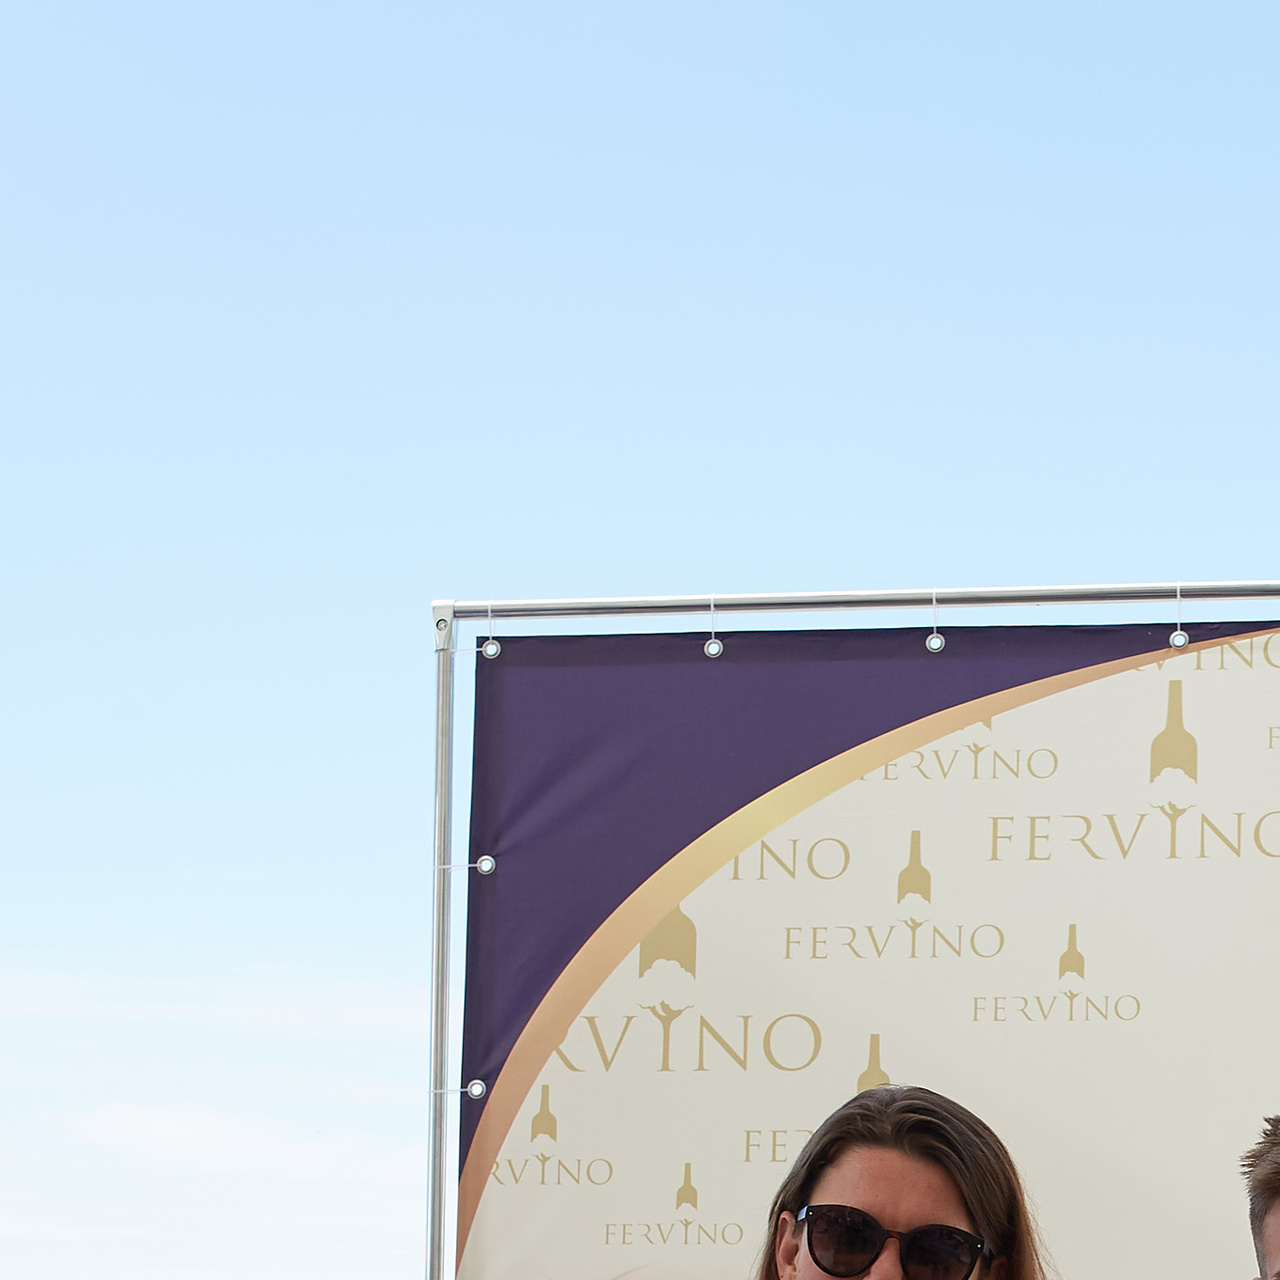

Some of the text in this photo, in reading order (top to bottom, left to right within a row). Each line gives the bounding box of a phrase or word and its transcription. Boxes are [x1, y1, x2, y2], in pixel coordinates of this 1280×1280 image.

[783, 917, 1005, 960] FERVINO
[971, 990, 1141, 1023] FERVINO
[604, 1218, 744, 1246] FERVINO
